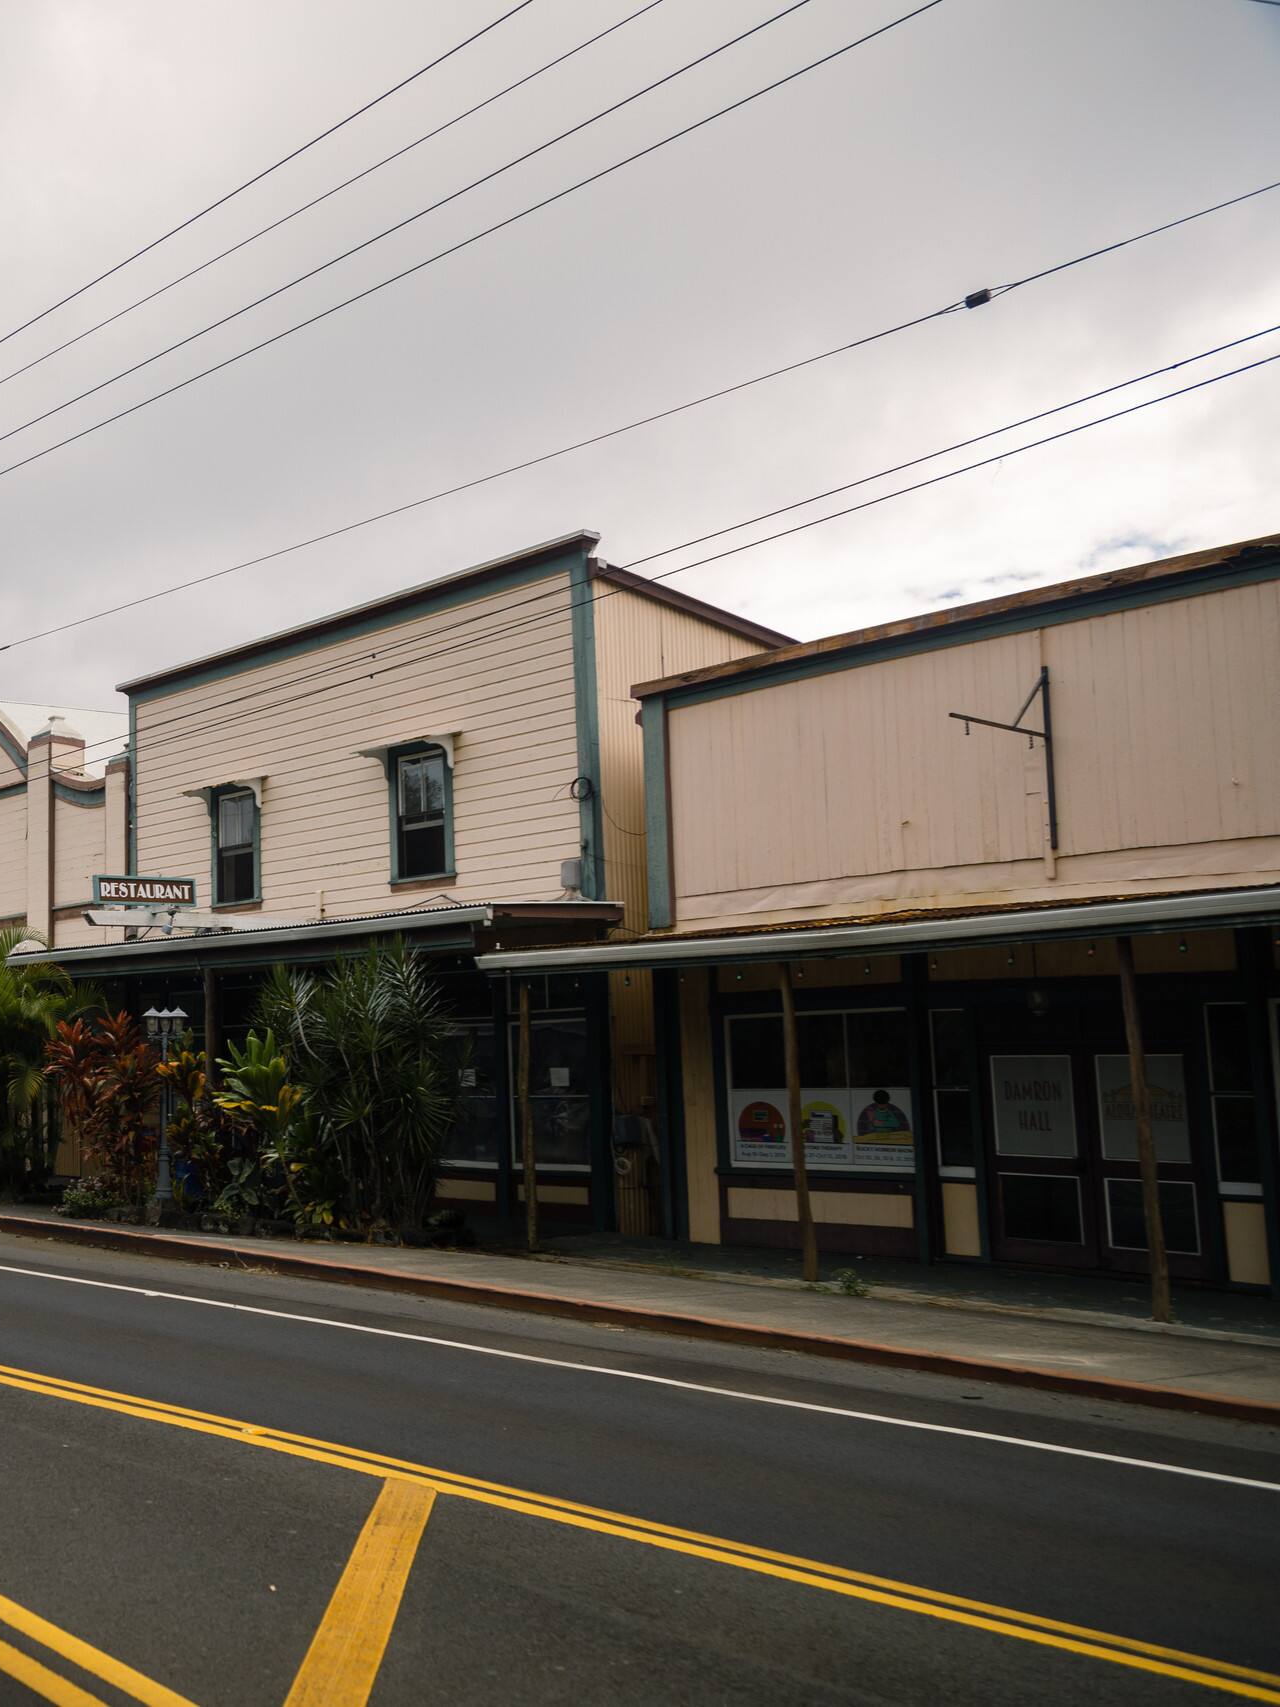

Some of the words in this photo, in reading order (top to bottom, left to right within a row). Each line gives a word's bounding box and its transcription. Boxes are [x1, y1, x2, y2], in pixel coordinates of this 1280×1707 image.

[100, 881, 191, 900] RESTAURANT
[1003, 1079, 1062, 1102] DAMRON
[1017, 1109, 1052, 1131] HALL
